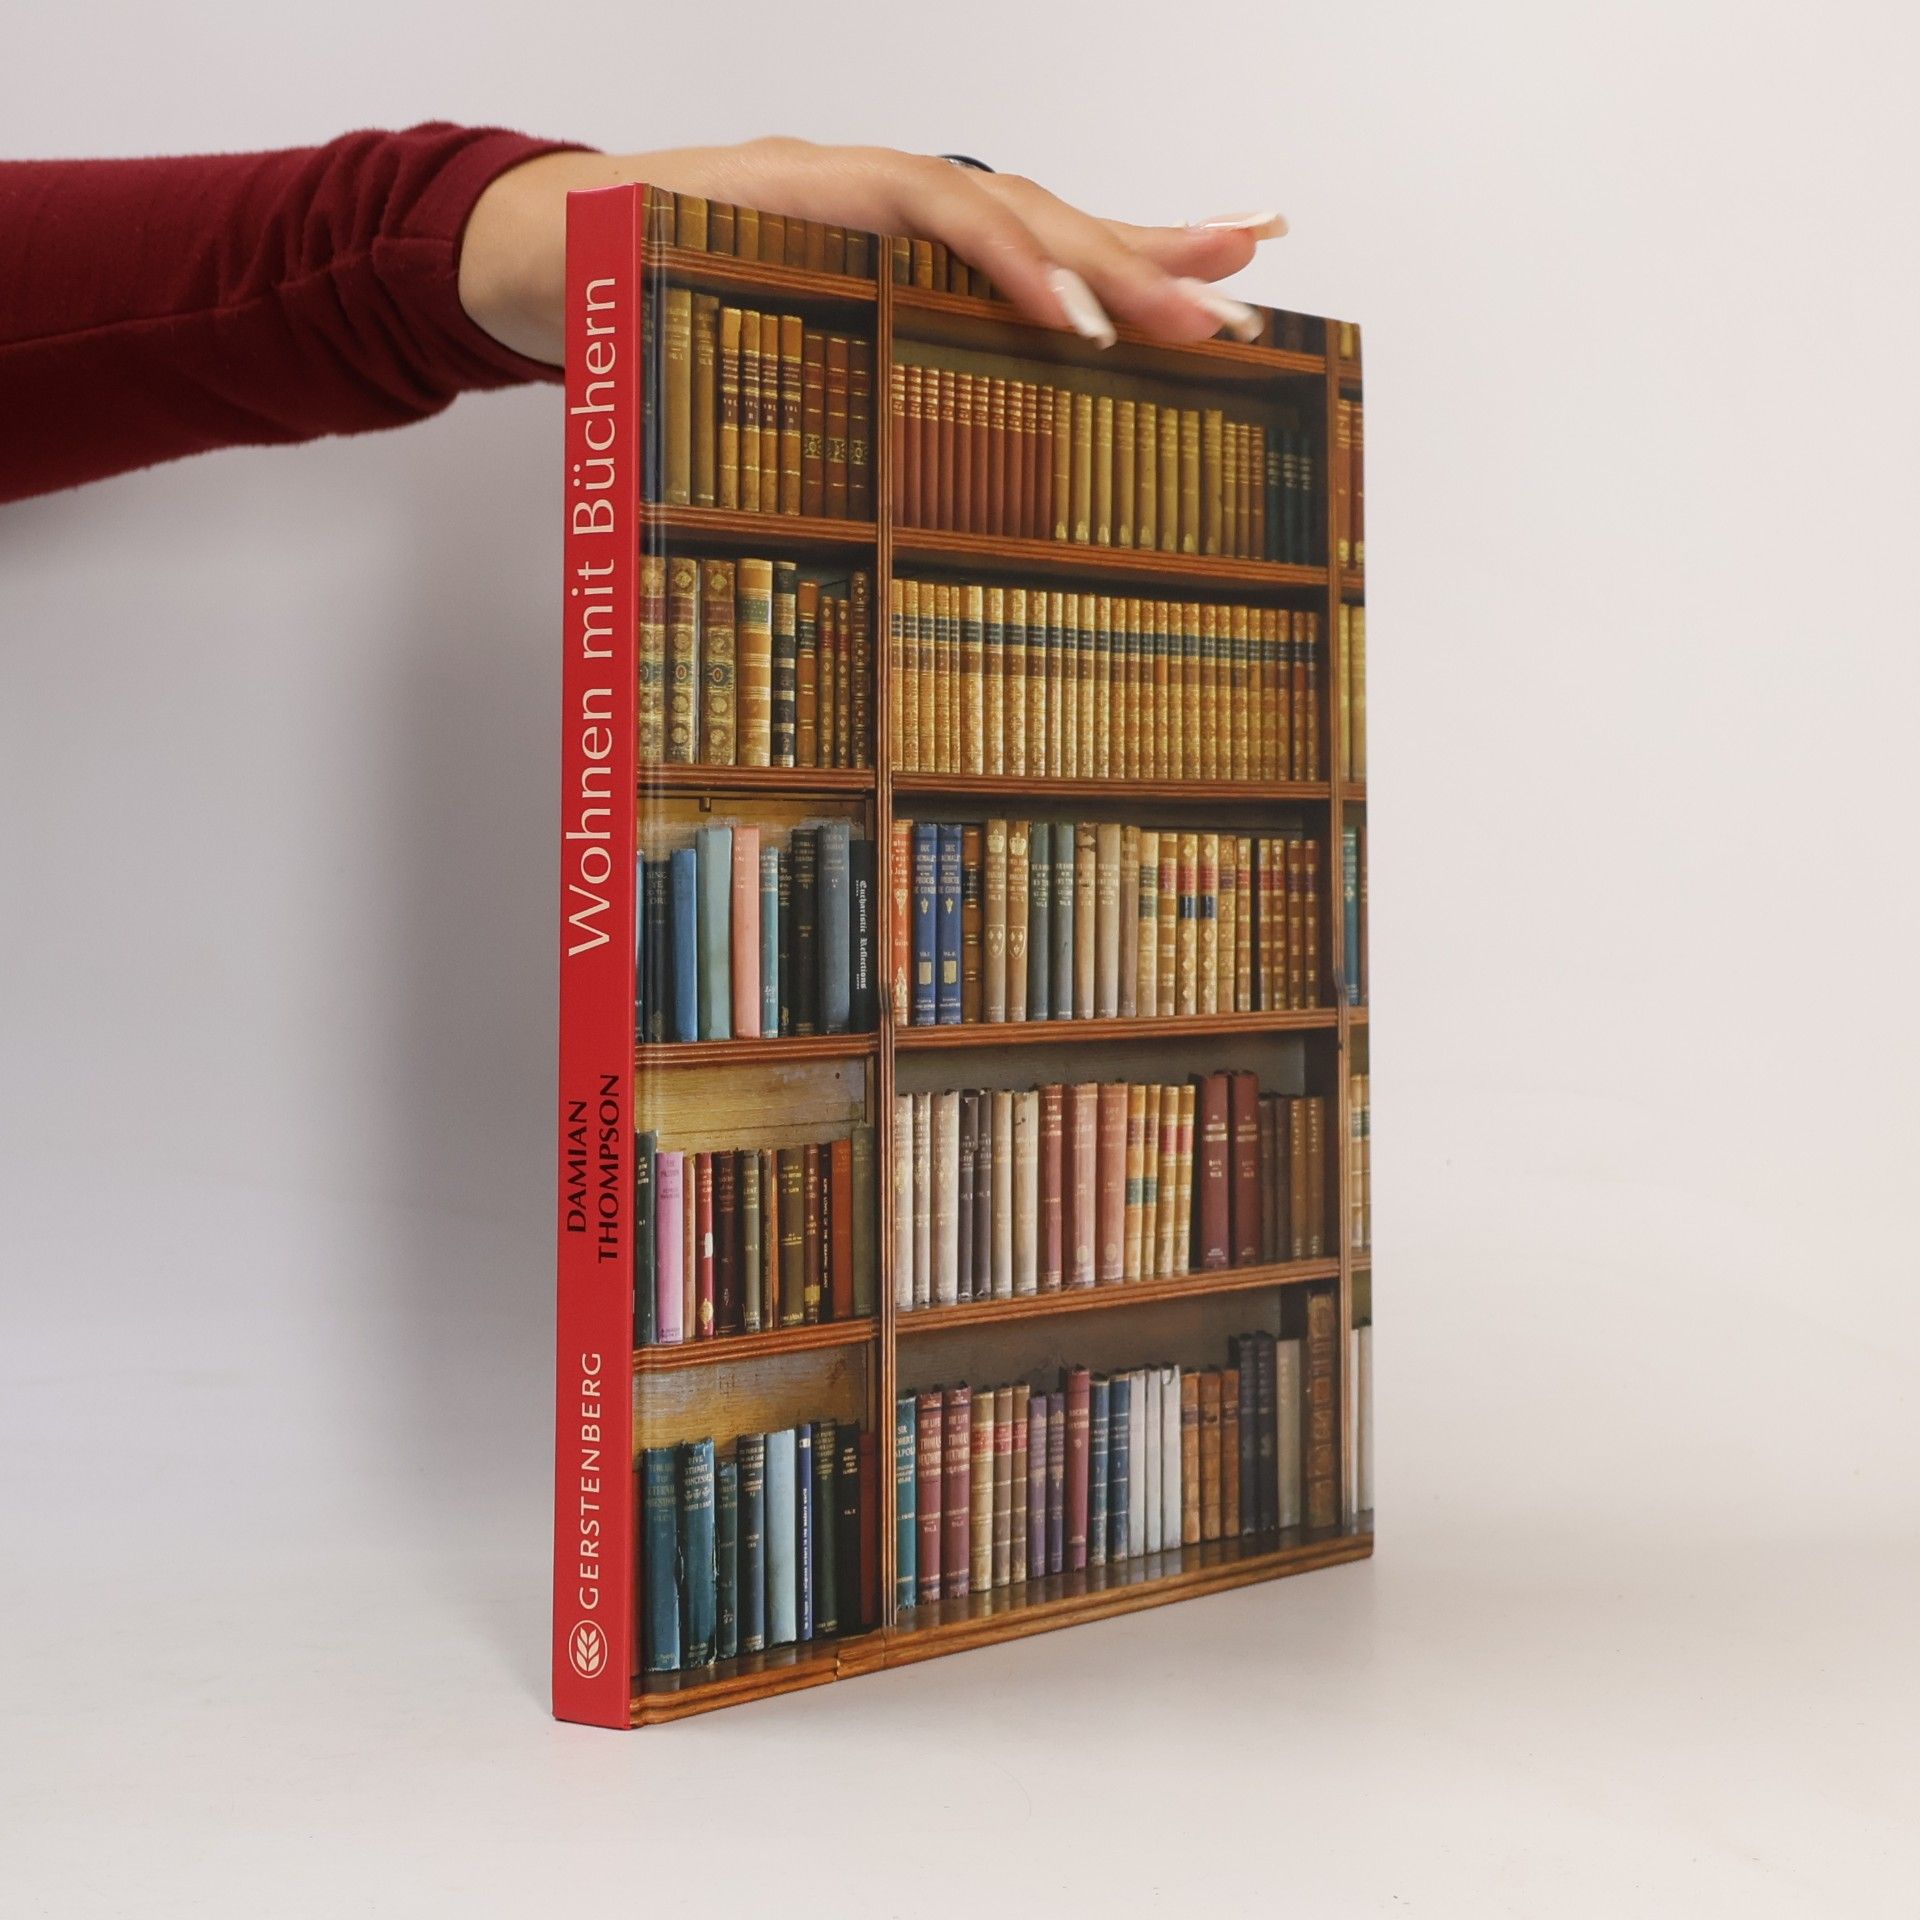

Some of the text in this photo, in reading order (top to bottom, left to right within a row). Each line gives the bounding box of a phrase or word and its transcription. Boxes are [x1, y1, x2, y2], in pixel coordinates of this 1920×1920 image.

[565, 278, 616, 957] Wohnen mit Büchern
[858, 937, 868, 990] Reflections
[859, 880, 868, 933] Eucharistic
[567, 1100, 587, 1233] DAMIAN
[598, 1074, 619, 1263] THOMPSON
[579, 1353, 601, 1610] GERSTENBERG
